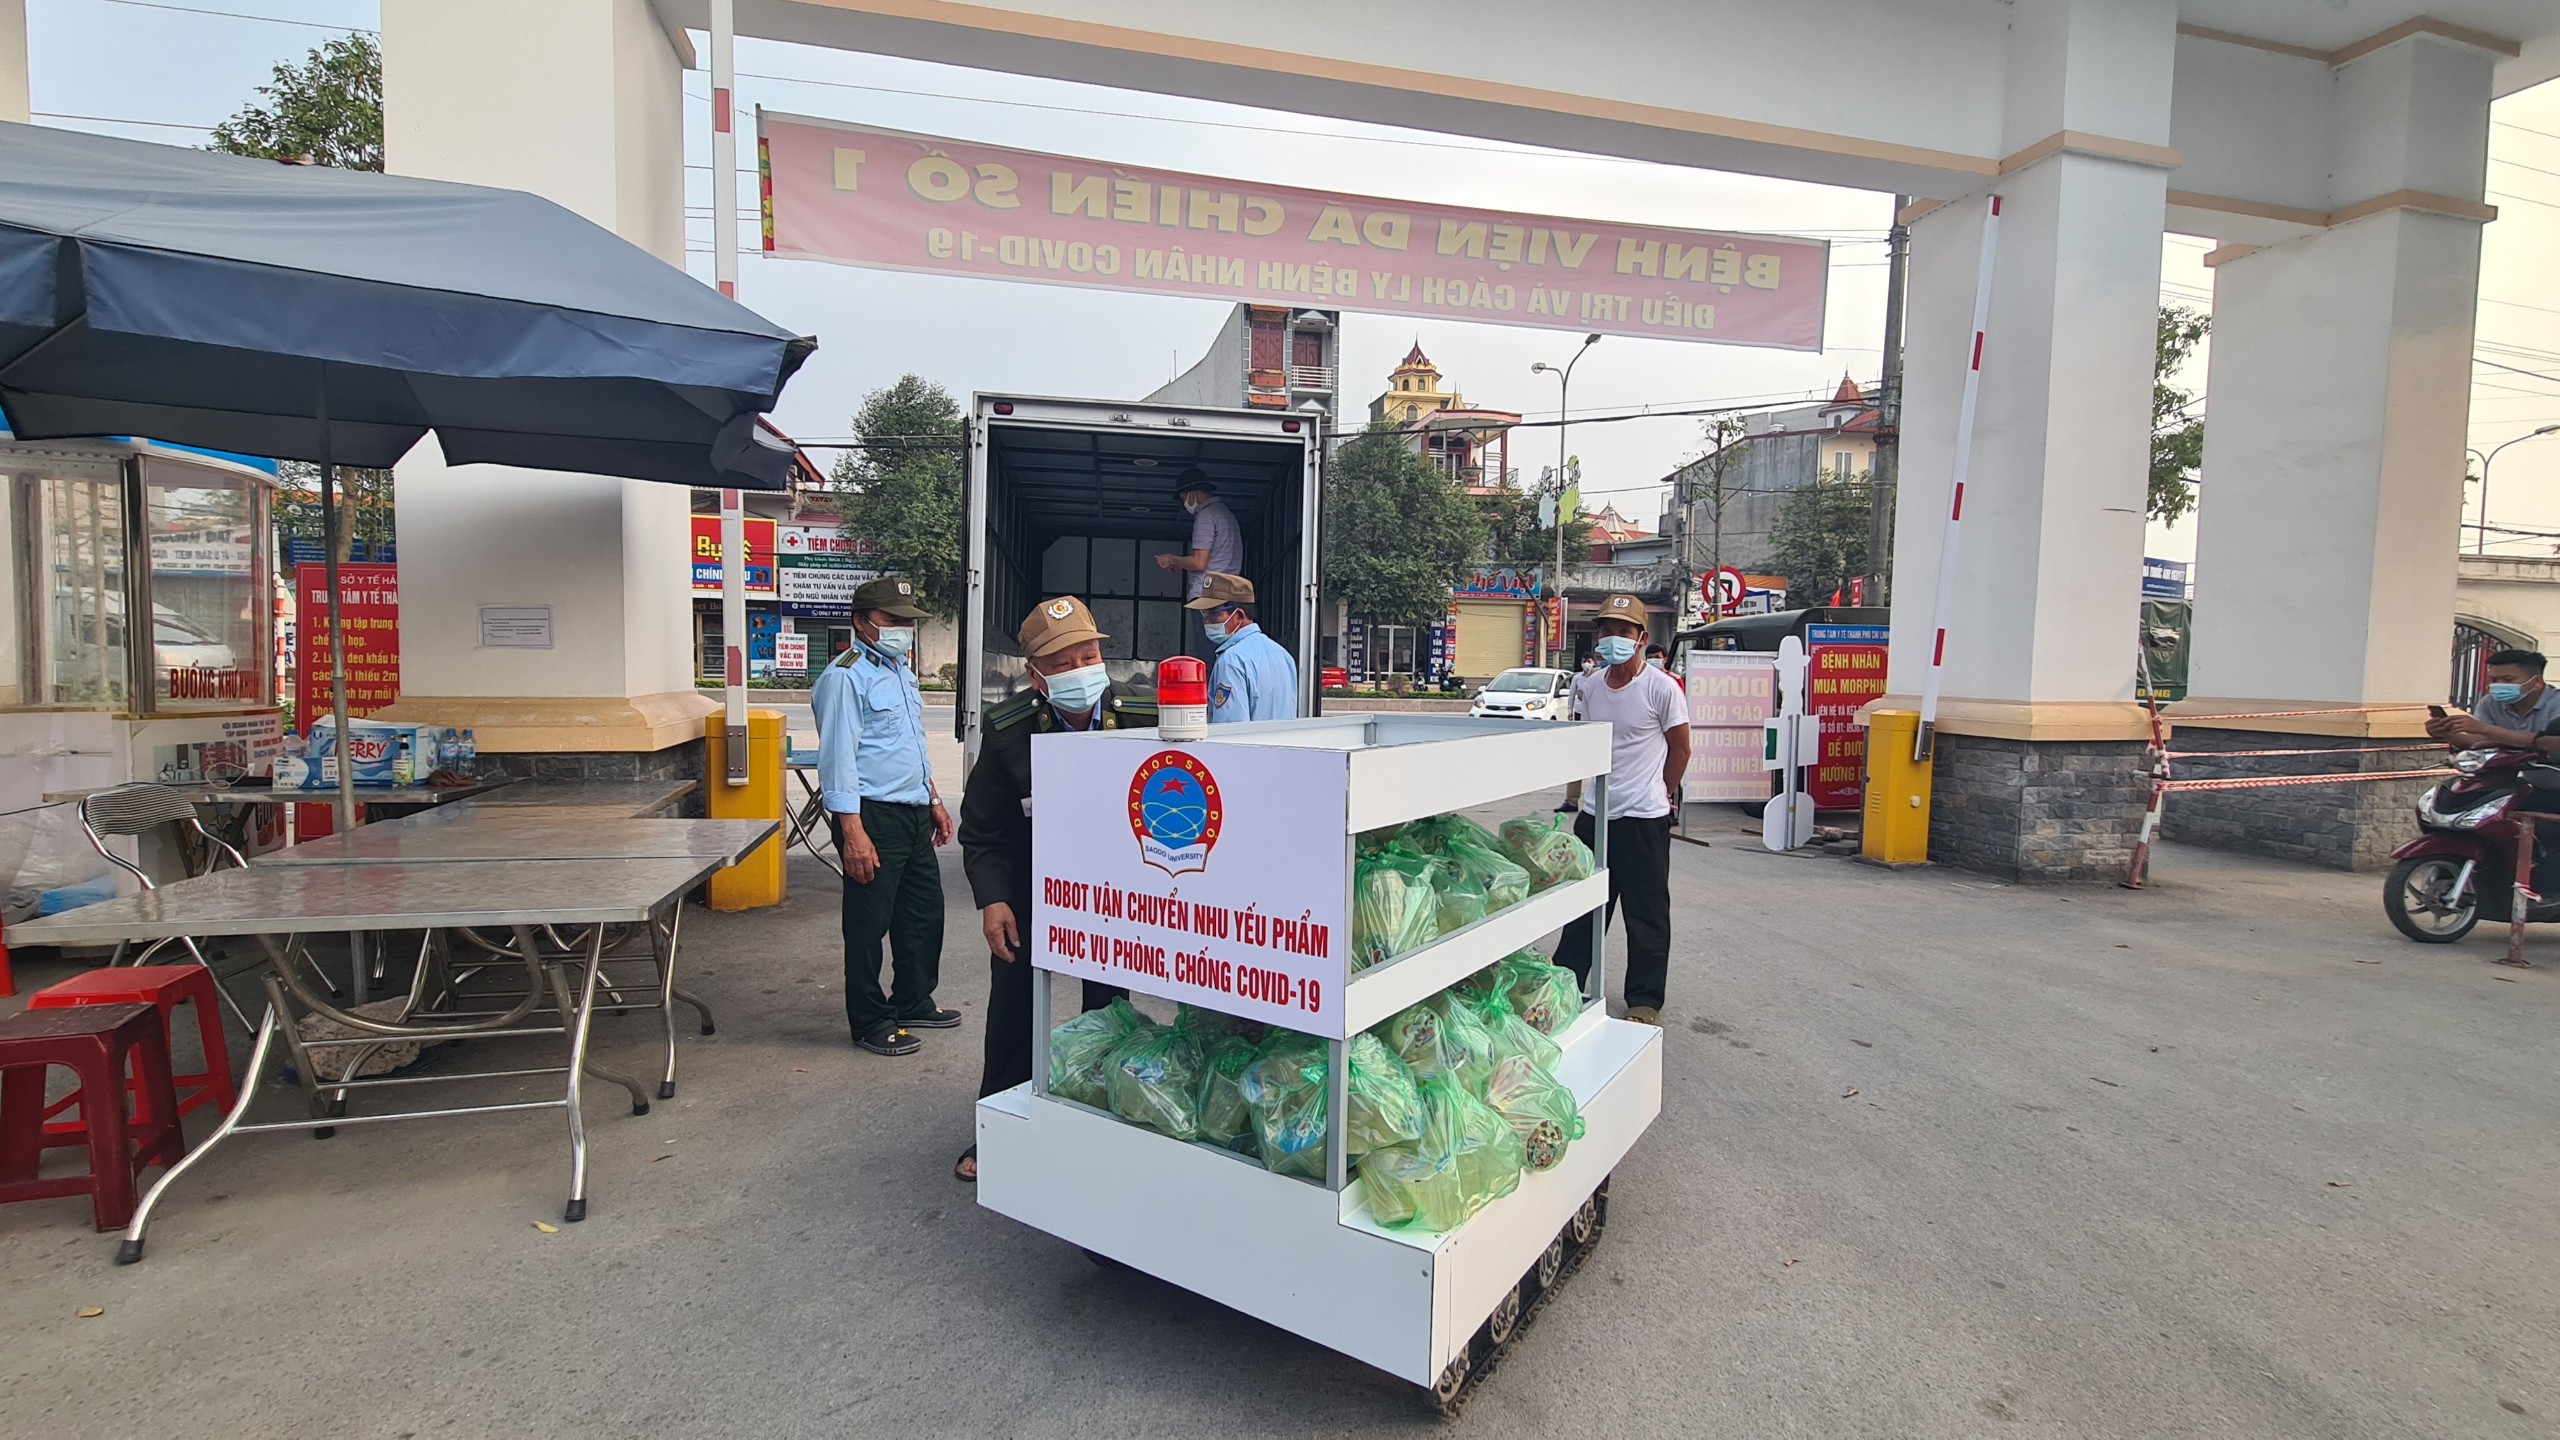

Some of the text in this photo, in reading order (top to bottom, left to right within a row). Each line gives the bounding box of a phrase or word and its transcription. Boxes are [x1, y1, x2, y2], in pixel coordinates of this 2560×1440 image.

[340, 573, 355, 585] SỞ
[357, 576, 365, 585] Y
[367, 573, 380, 585] TẾ
[311, 589, 329, 604] TRU
[341, 588, 360, 605] TÂM
[362, 590, 369, 604] Y
[312, 616, 393, 631] 1. Kng tập trung
[347, 636, 367, 649] họp.
[312, 652, 321, 663] 2.
[1821, 650, 1880, 672] BỆNH NHÂN
[311, 686, 321, 699] 3.
[357, 688, 372, 701] tay
[1813, 678, 1838, 695] MUA
[2137, 688, 2171, 698] DNG
[334, 740, 389, 759] ERRY
[1827, 736, 1864, 760] ĐỂ ĐƯỢ
[1140, 755, 1174, 780] HỌC
[1185, 760, 1215, 795] SAO
[1819, 762, 1855, 782] HƯỚNG
[1167, 852, 1204, 862] UNIVERSITY
[1044, 876, 1329, 959] ROBOT VẬN CHUYỂN NHU YẾU PHẨM
[1048, 924, 1321, 1013] PHỤC VỤ PHÒNG, CHỐNG COVID-19
